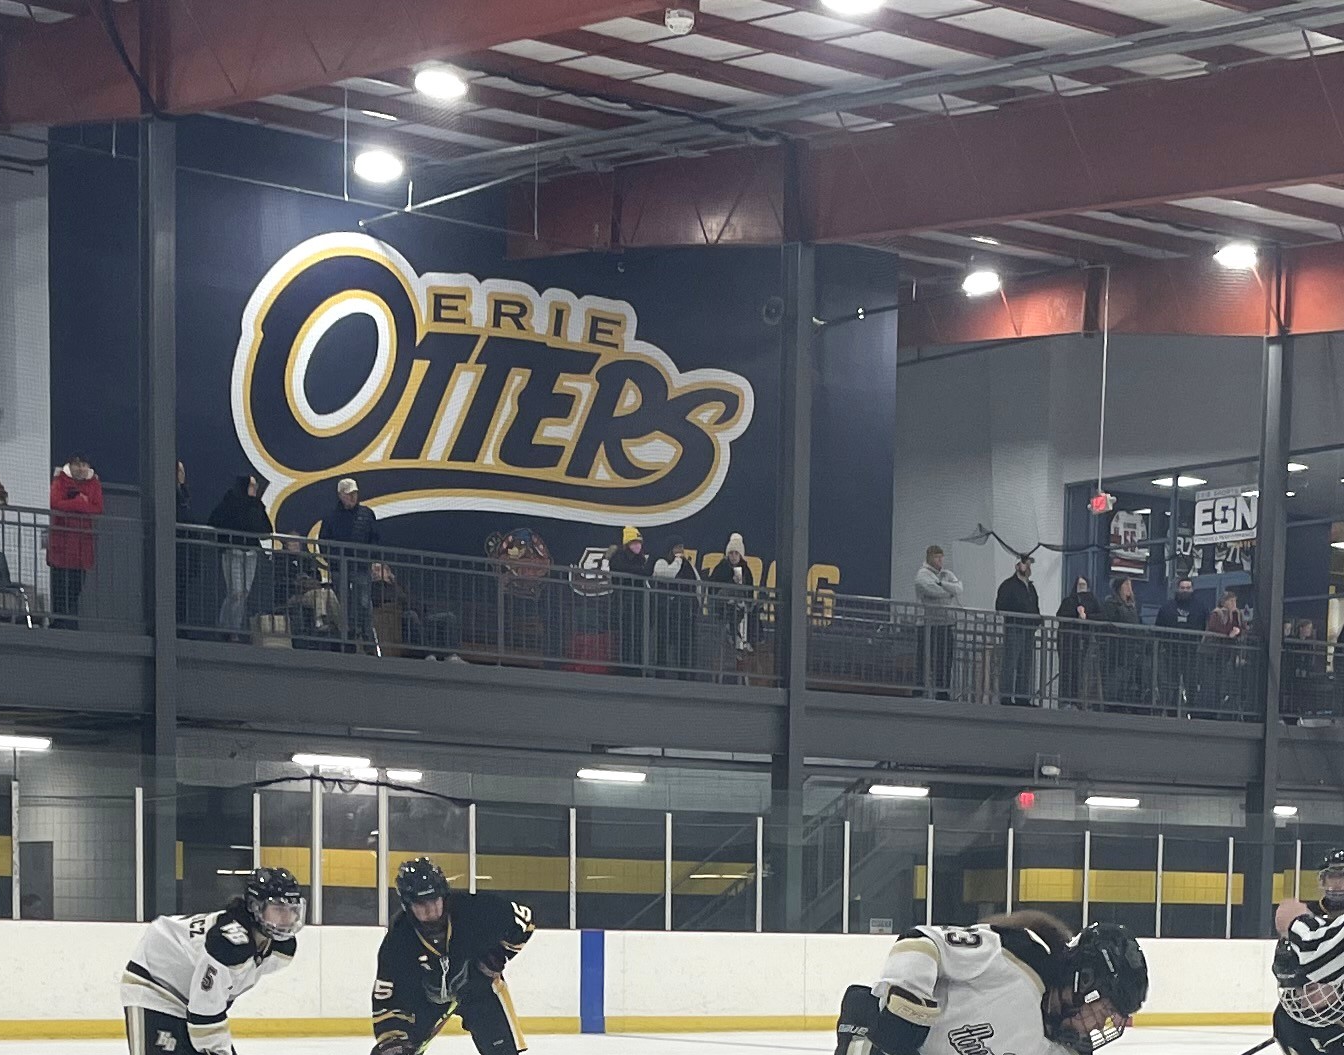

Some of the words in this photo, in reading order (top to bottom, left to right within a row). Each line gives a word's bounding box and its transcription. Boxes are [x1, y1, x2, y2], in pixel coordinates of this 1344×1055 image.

[428, 289, 624, 350] ERIE
[236, 240, 746, 490] OTTERS
[1195, 496, 1257, 535] ESN
[201, 963, 218, 992] 5
